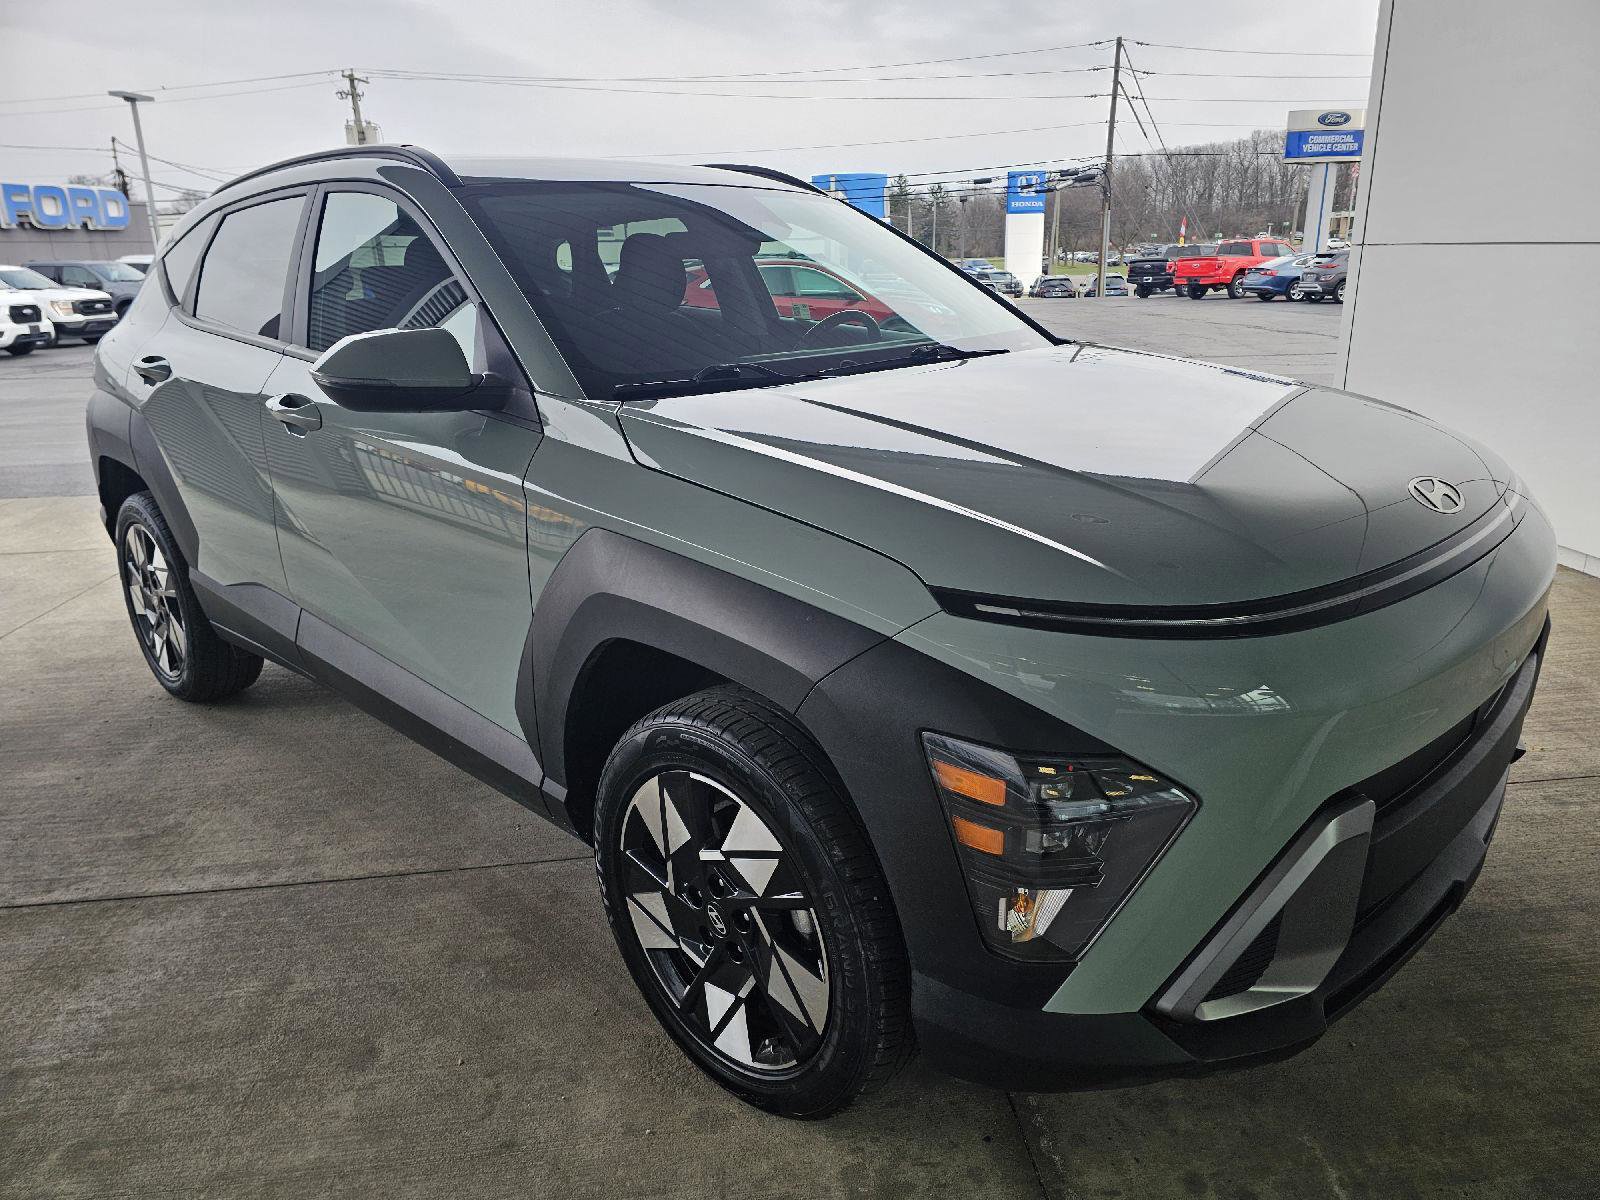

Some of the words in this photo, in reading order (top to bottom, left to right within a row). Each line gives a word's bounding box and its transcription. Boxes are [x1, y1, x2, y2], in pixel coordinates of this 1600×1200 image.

[1325, 114, 1346, 123] Ford
[1308, 134, 1354, 144] COMMERCIAL
[1302, 144, 1332, 152] VEHICLE
[1332, 142, 1358, 152] CENTER
[0, 182, 131, 230] FORD
